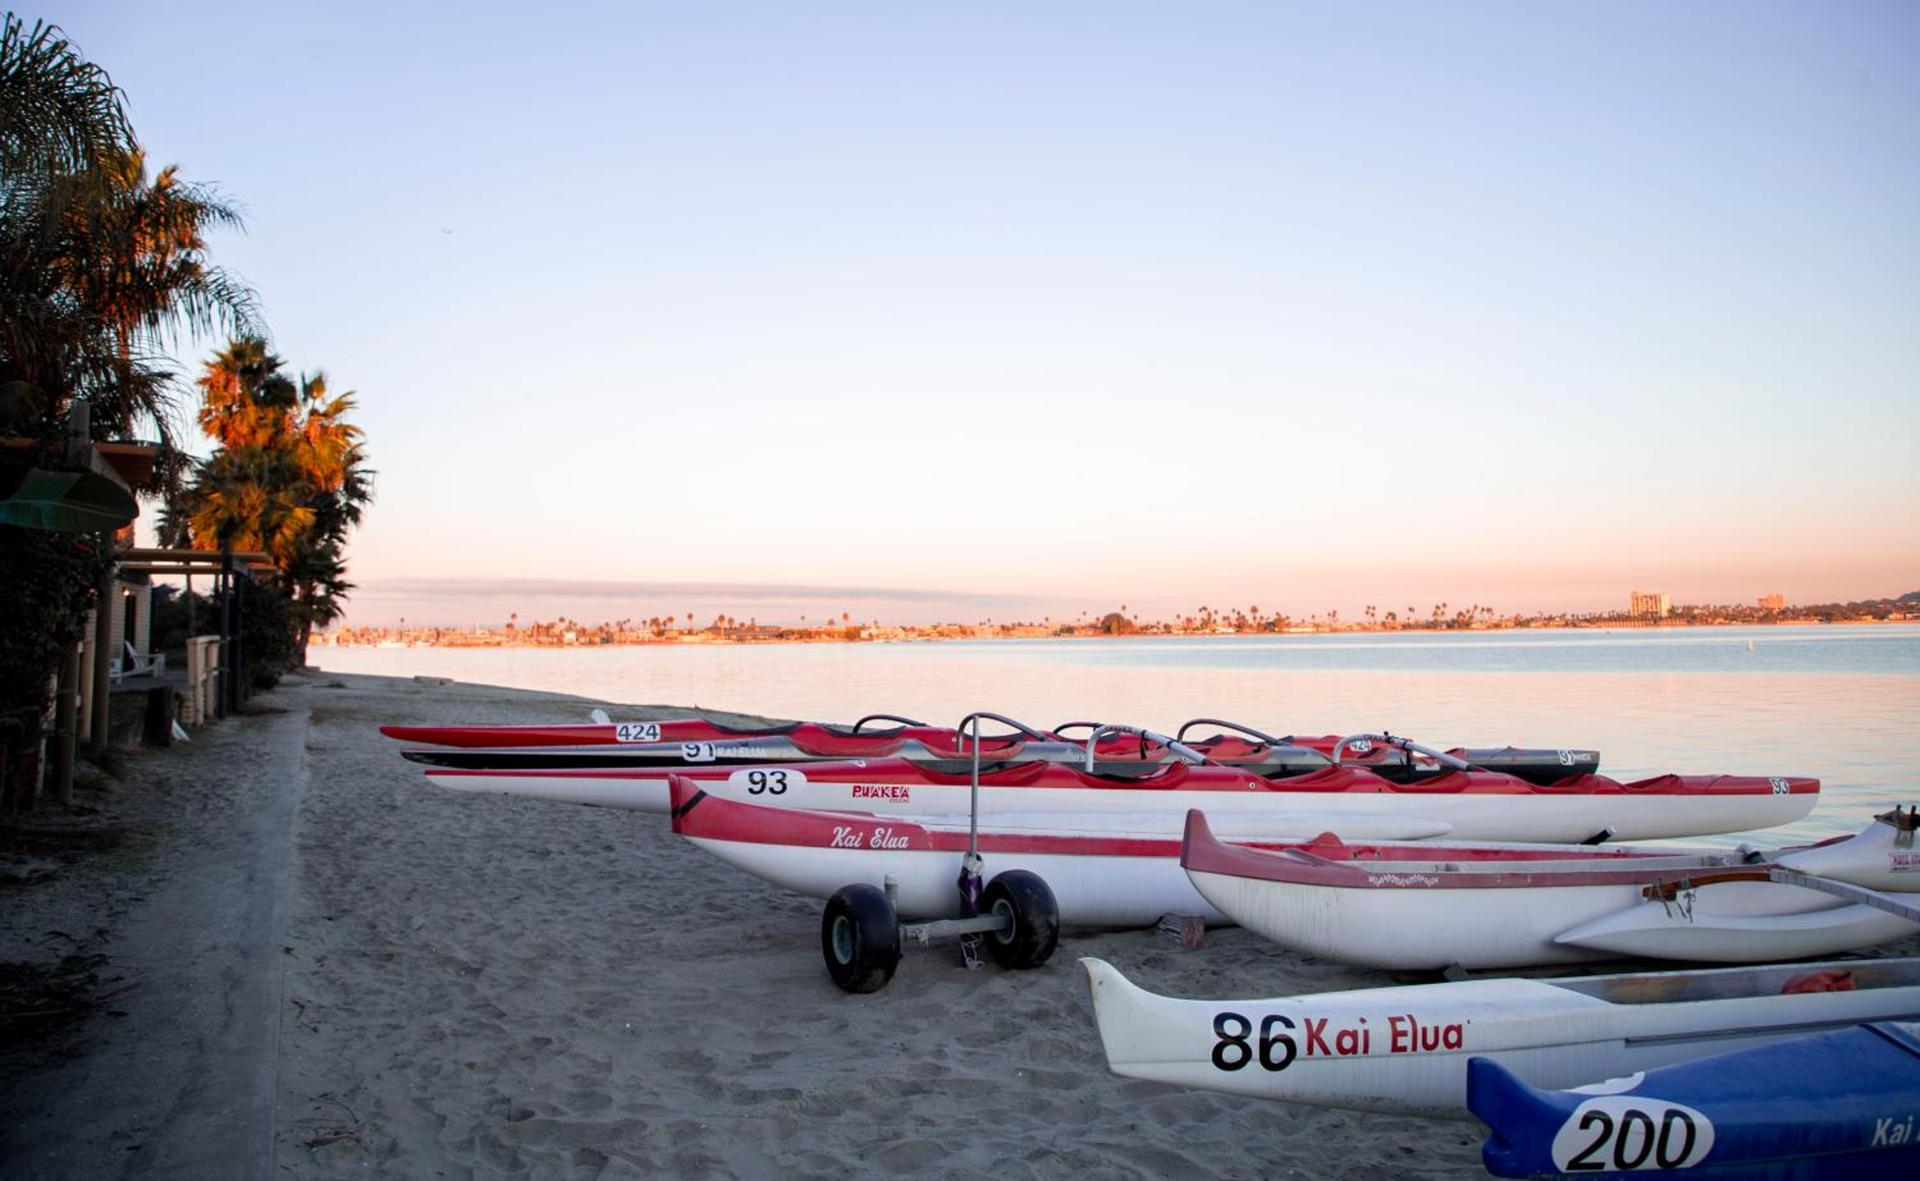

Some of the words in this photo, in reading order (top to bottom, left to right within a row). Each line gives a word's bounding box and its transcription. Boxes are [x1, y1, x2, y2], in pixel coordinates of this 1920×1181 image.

[618, 724, 659, 741] 424
[685, 743, 714, 758] 91
[1560, 750, 1574, 764] 91
[748, 771, 788, 795] 93
[852, 785, 910, 798] PUAKEA
[1772, 778, 1788, 794] 93
[830, 826, 864, 848] Kai
[870, 827, 910, 849] Elua
[1211, 1012, 1298, 1072] 86
[1303, 1017, 1371, 1056] Kai
[1388, 1014, 1463, 1054] Elua
[1566, 1109, 1697, 1171] 200
[1871, 1115, 1914, 1147] Kai
